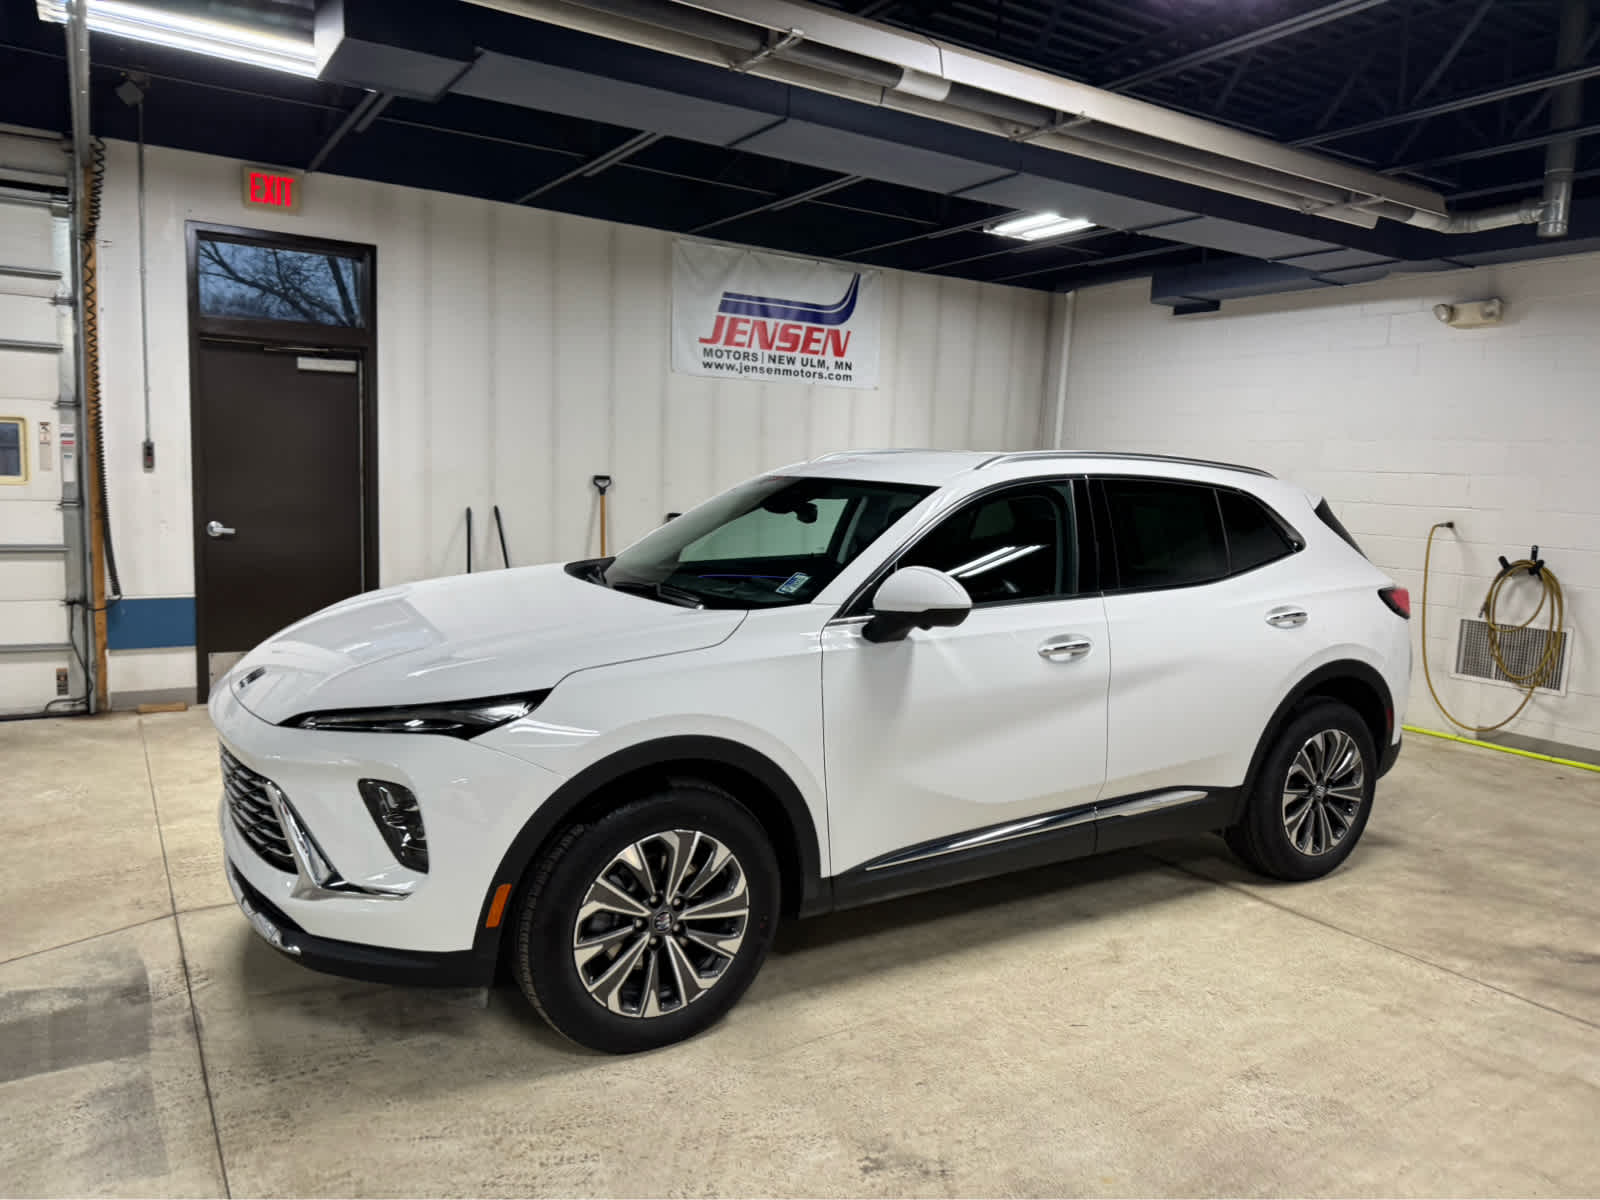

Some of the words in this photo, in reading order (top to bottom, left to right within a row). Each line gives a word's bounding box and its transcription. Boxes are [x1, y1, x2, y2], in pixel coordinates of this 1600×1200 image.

[250, 173, 295, 207] EXIT
[699, 315, 851, 358] JENSEN
[702, 360, 852, 382] www.jensenmotors.com
[703, 348, 758, 362] MOTORS
[768, 355, 796, 366] NEW
[801, 357, 829, 370] ULM,
[834, 361, 853, 371] MN
